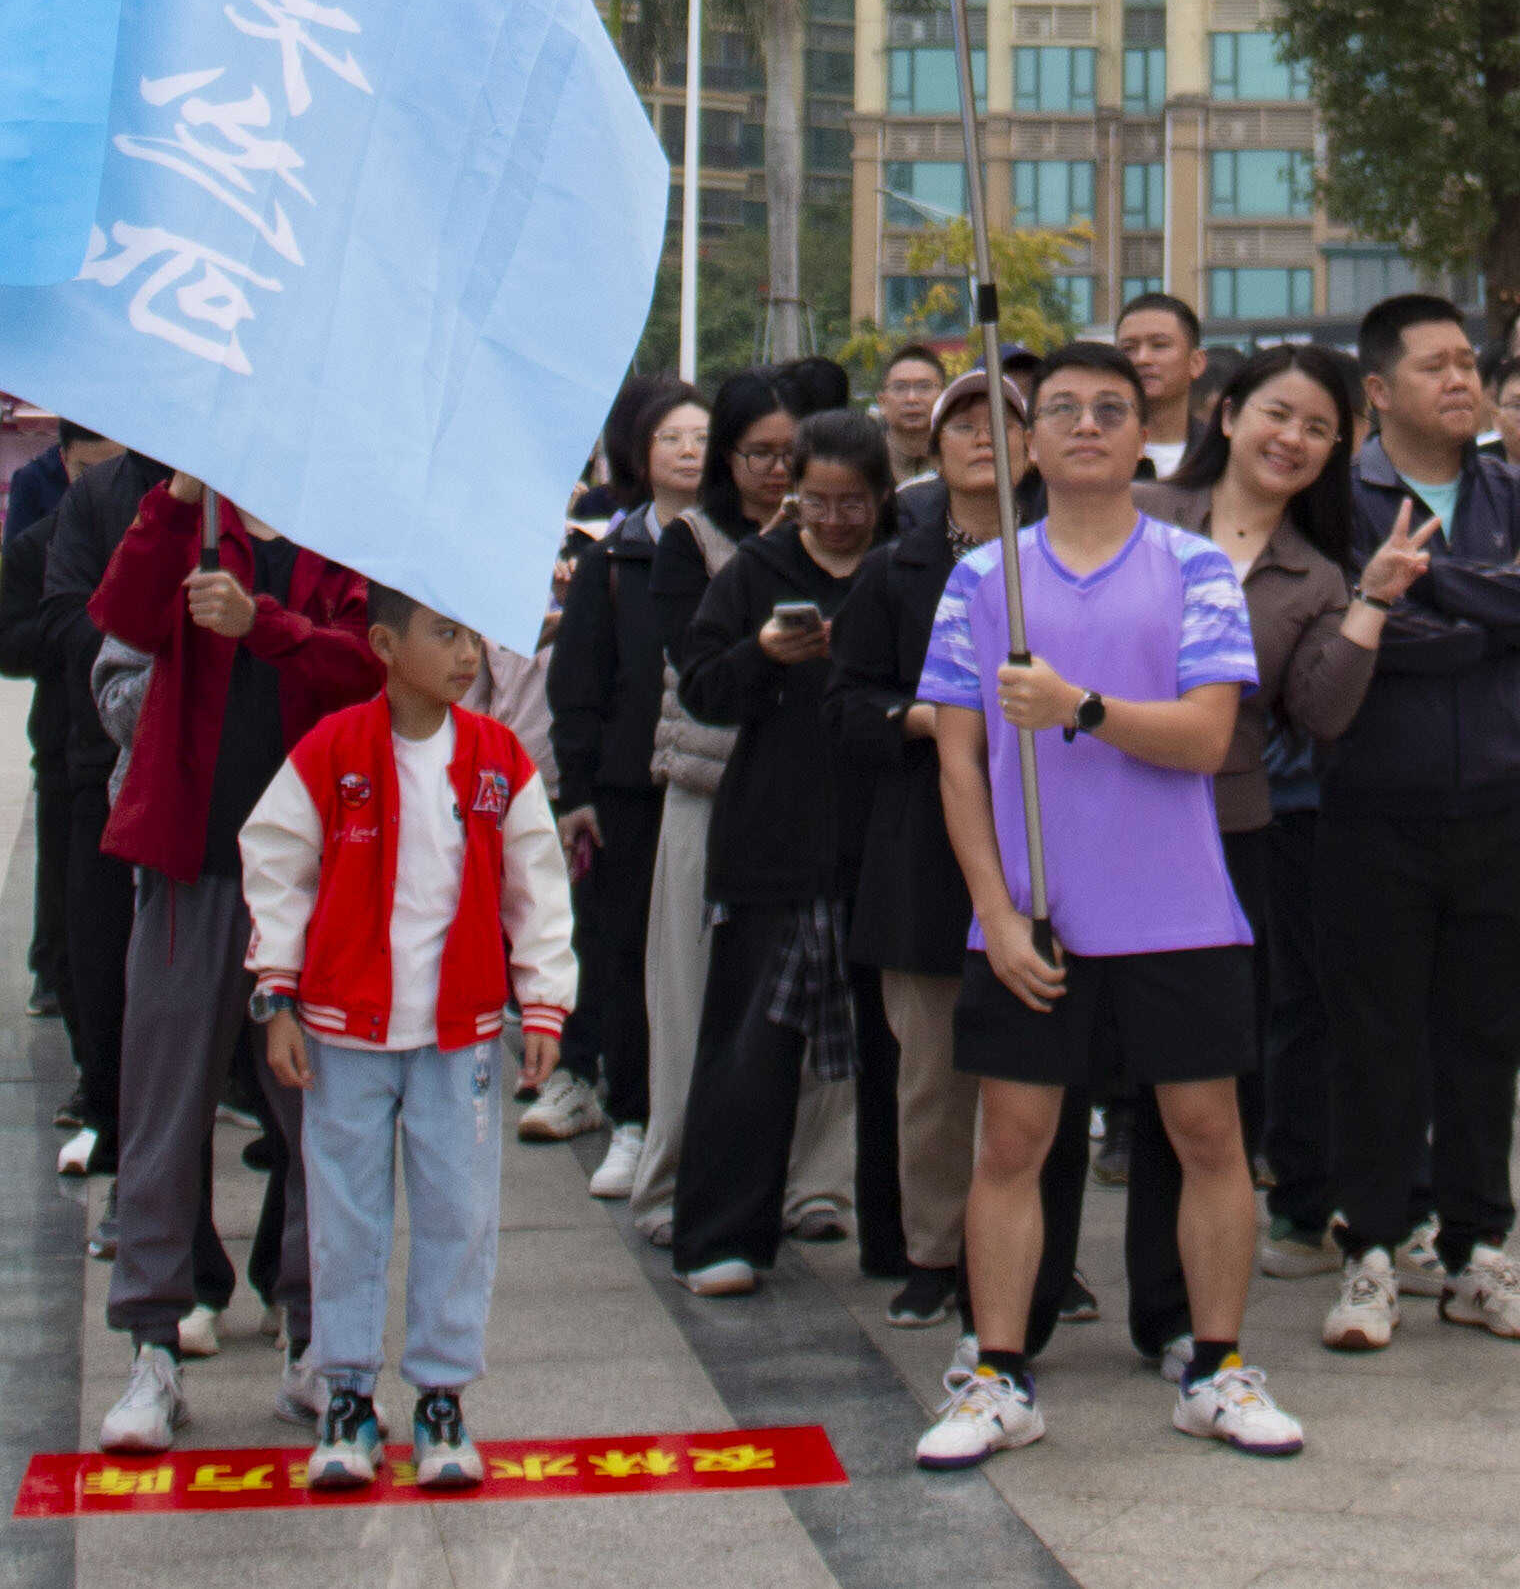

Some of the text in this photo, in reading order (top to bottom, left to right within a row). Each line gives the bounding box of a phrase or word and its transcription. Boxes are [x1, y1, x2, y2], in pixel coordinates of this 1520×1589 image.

[84, 1444, 776, 1495] 农林水方阵
